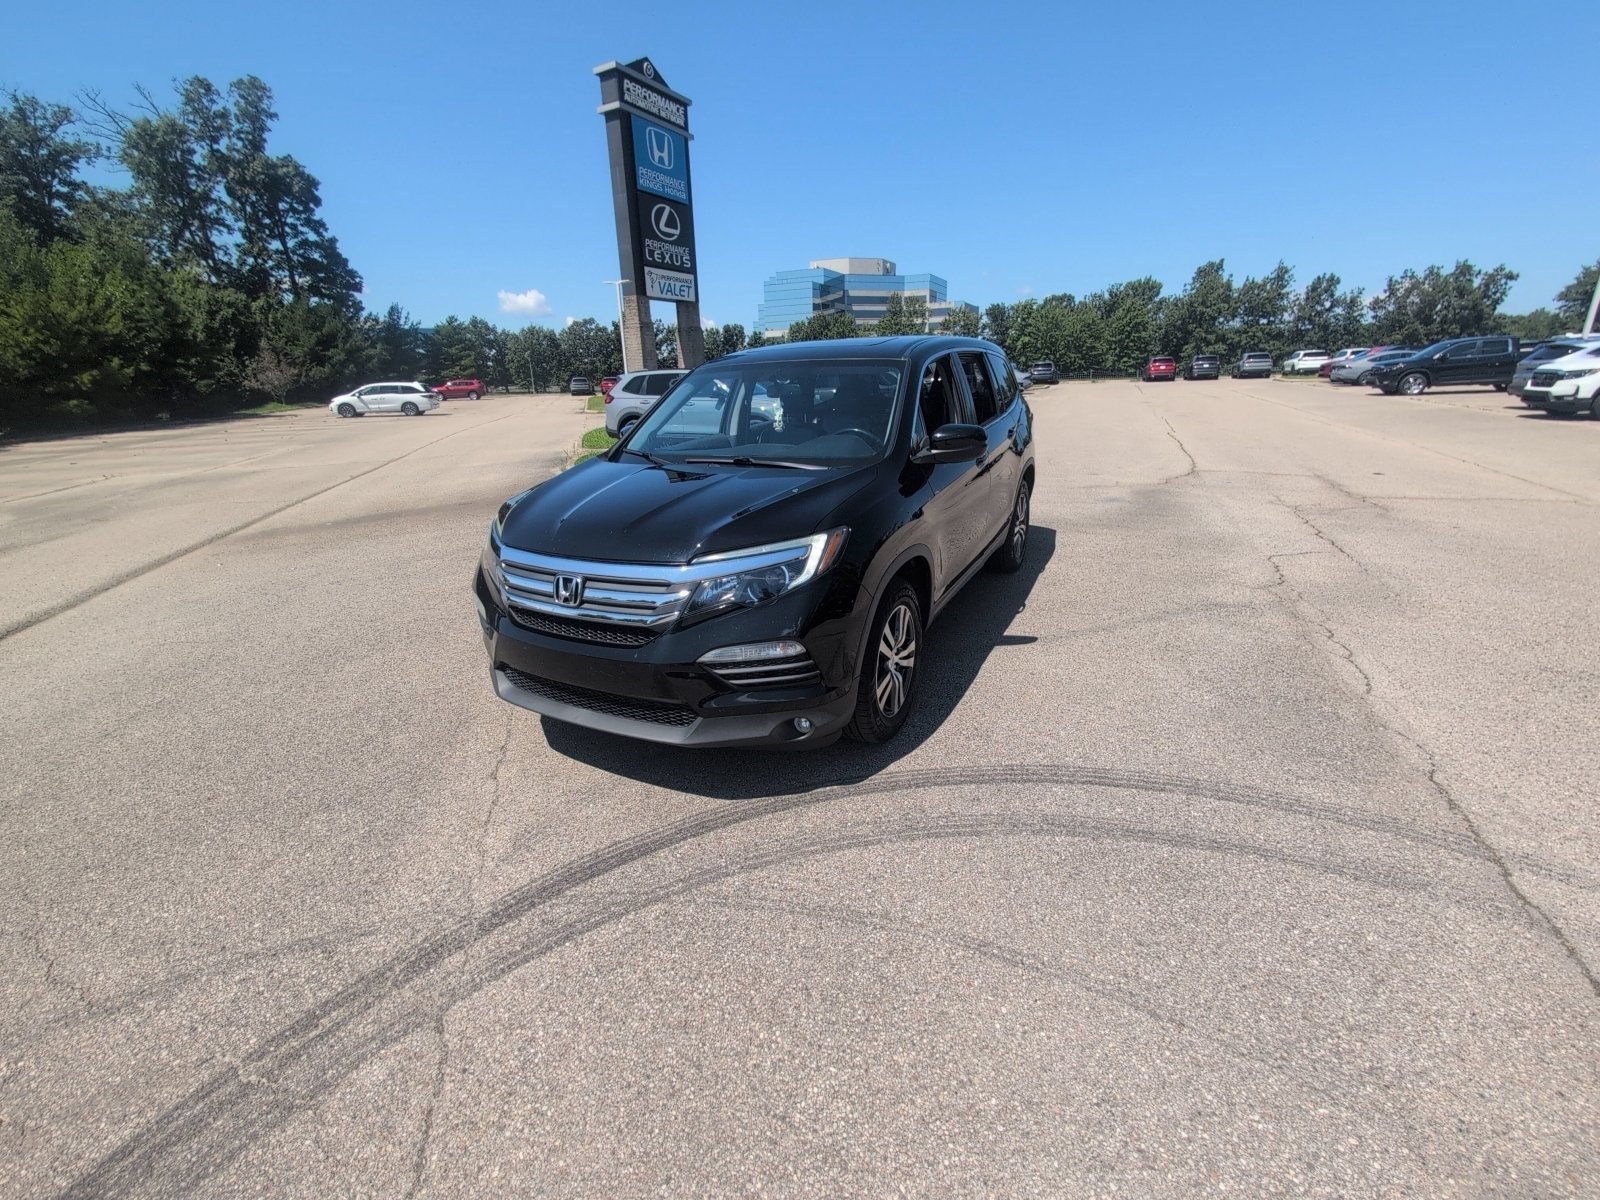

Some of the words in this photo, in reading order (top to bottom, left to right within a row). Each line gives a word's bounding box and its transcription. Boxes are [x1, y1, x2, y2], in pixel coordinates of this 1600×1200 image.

[624, 79, 685, 115] PERFORMANCE
[660, 107, 685, 127] NETWORK
[638, 166, 686, 188] PERFORMANCE
[639, 179, 663, 192] KINGS
[645, 238, 690, 255] PERFORMANCE
[646, 247, 691, 268] LEXUS
[658, 280, 692, 298] VALET
[660, 274, 692, 285] PERFORMANCE
